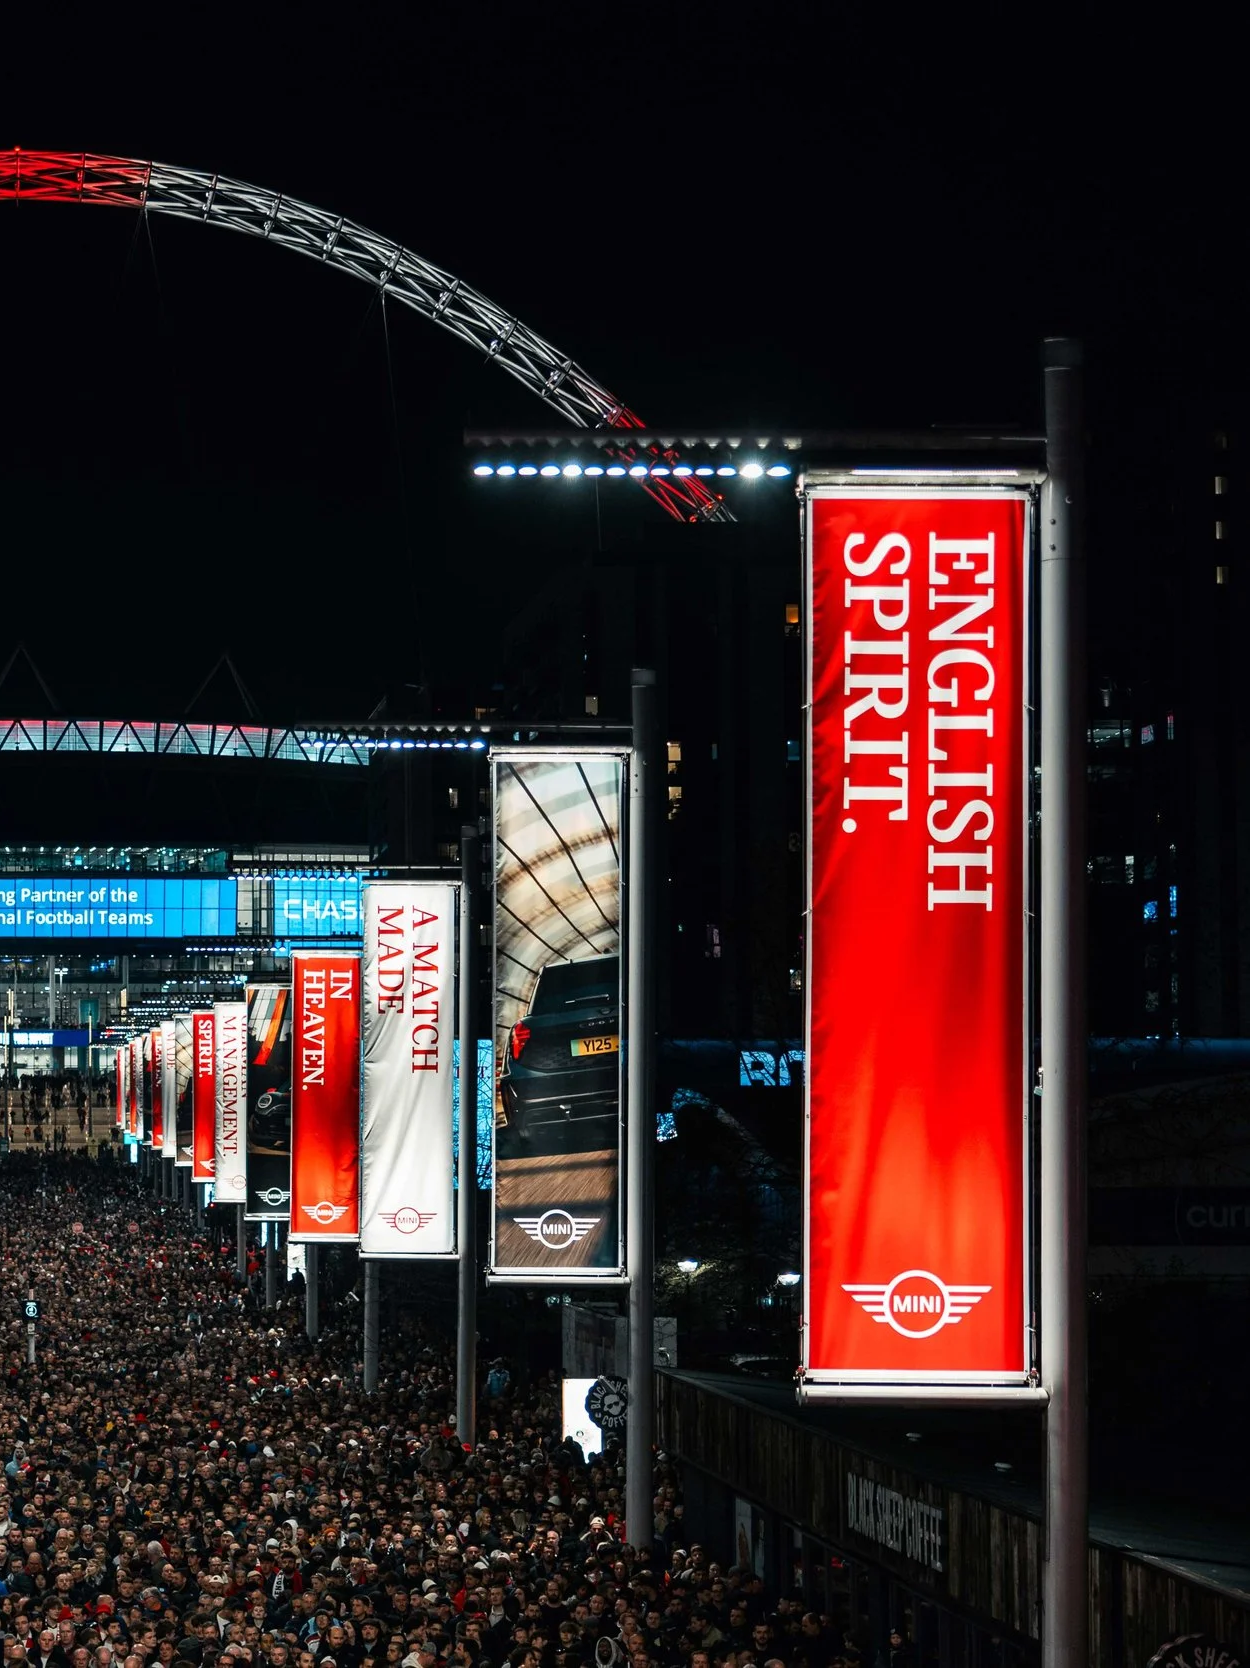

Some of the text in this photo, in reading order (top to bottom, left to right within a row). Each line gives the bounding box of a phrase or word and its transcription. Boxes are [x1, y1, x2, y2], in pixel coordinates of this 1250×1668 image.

[842, 532, 912, 834] SPIRIT.
[927, 531, 995, 911] ENGLISH
[21, 888, 83, 903] Partner
[89, 888, 105, 903] of
[110, 888, 138, 903] the
[26, 910, 94, 925] Football
[98, 910, 154, 925] Teams
[284, 899, 363, 919] CHAS
[331, 969, 352, 1001] IN
[377, 905, 404, 1014] MADE
[412, 905, 439, 1073] A MATCH
[198, 1019, 213, 1078] SPIRIT.
[302, 969, 326, 1091] HEAVEN.
[223, 1016, 238, 1157] MANAGEMENT.
[542, 1223, 571, 1236] MINI
[893, 1294, 941, 1314] MINI
